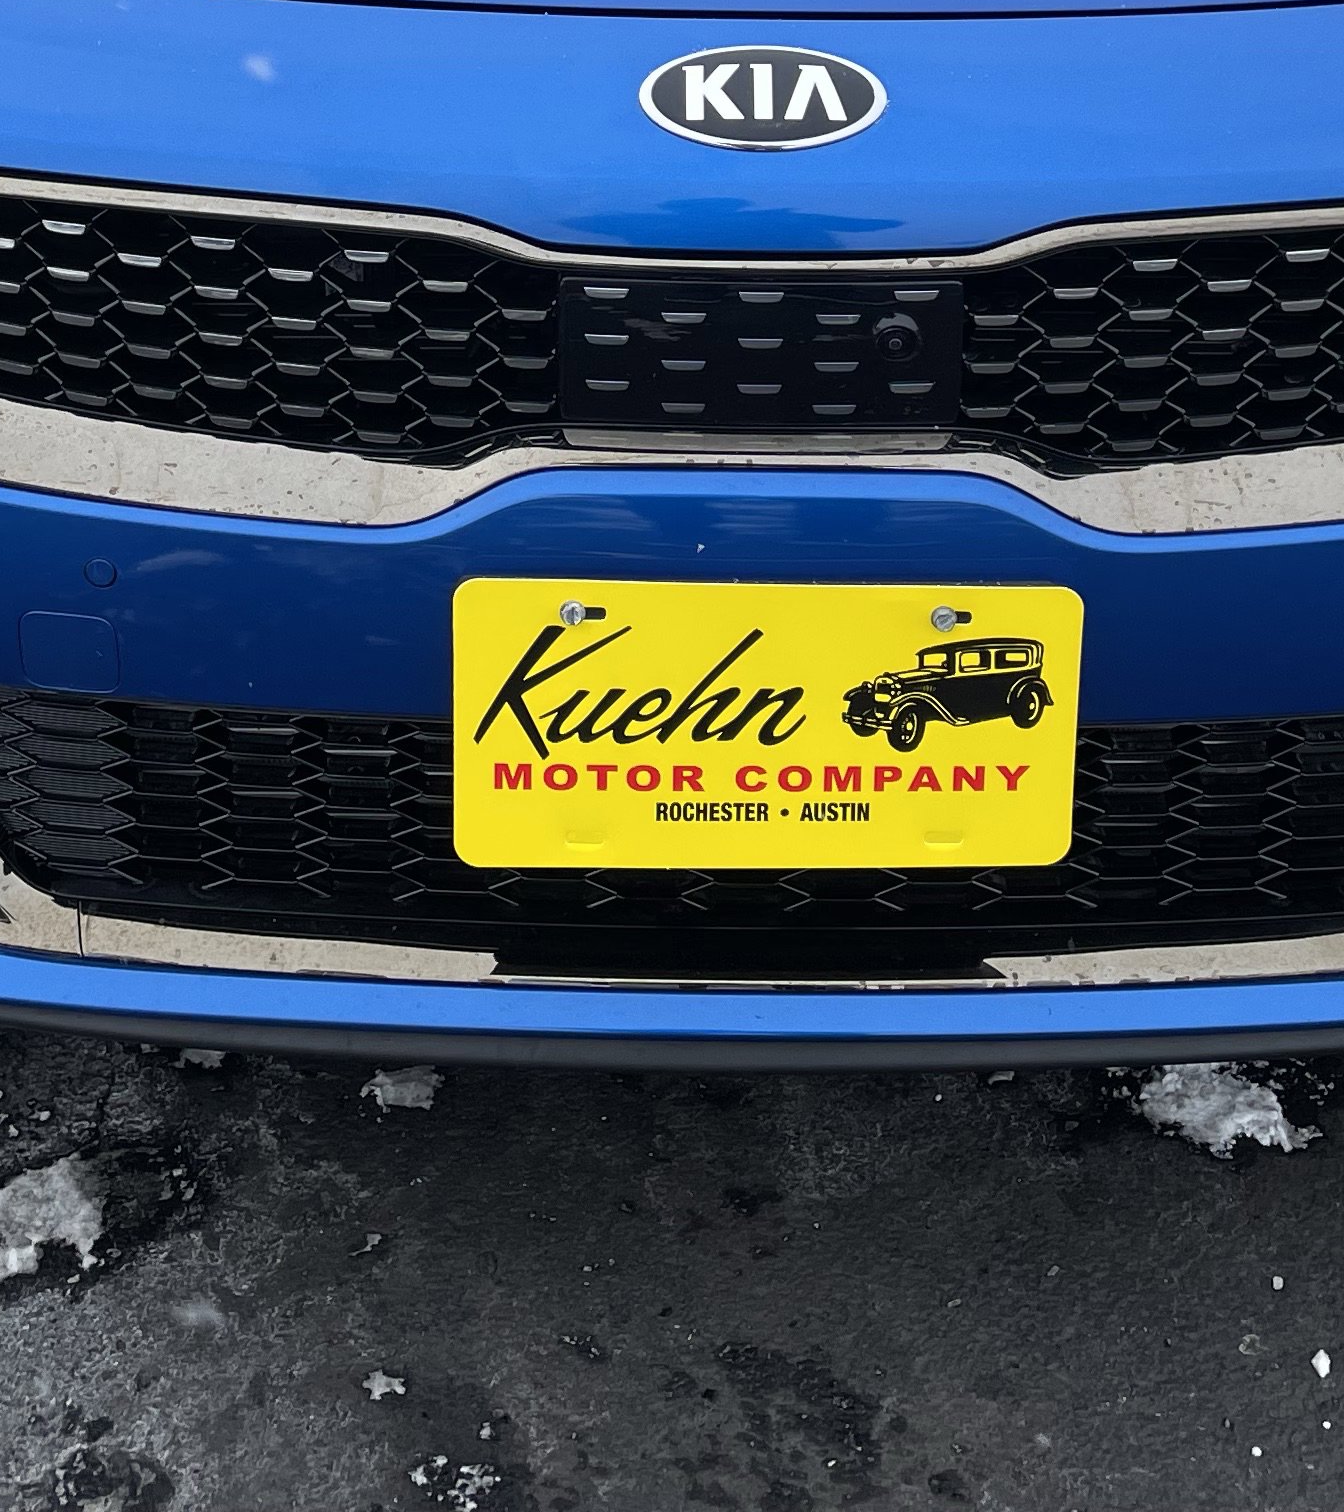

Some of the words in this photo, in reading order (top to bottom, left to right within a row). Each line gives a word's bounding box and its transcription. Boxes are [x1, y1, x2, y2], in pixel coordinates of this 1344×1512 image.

[681, 63, 849, 121] KIA
[473, 624, 808, 760] Kuehn
[493, 763, 706, 792] MOTOR
[735, 764, 1032, 793] COMPANY
[655, 802, 770, 823] ROCHESTER
[800, 802, 871, 823] AUSTIN
